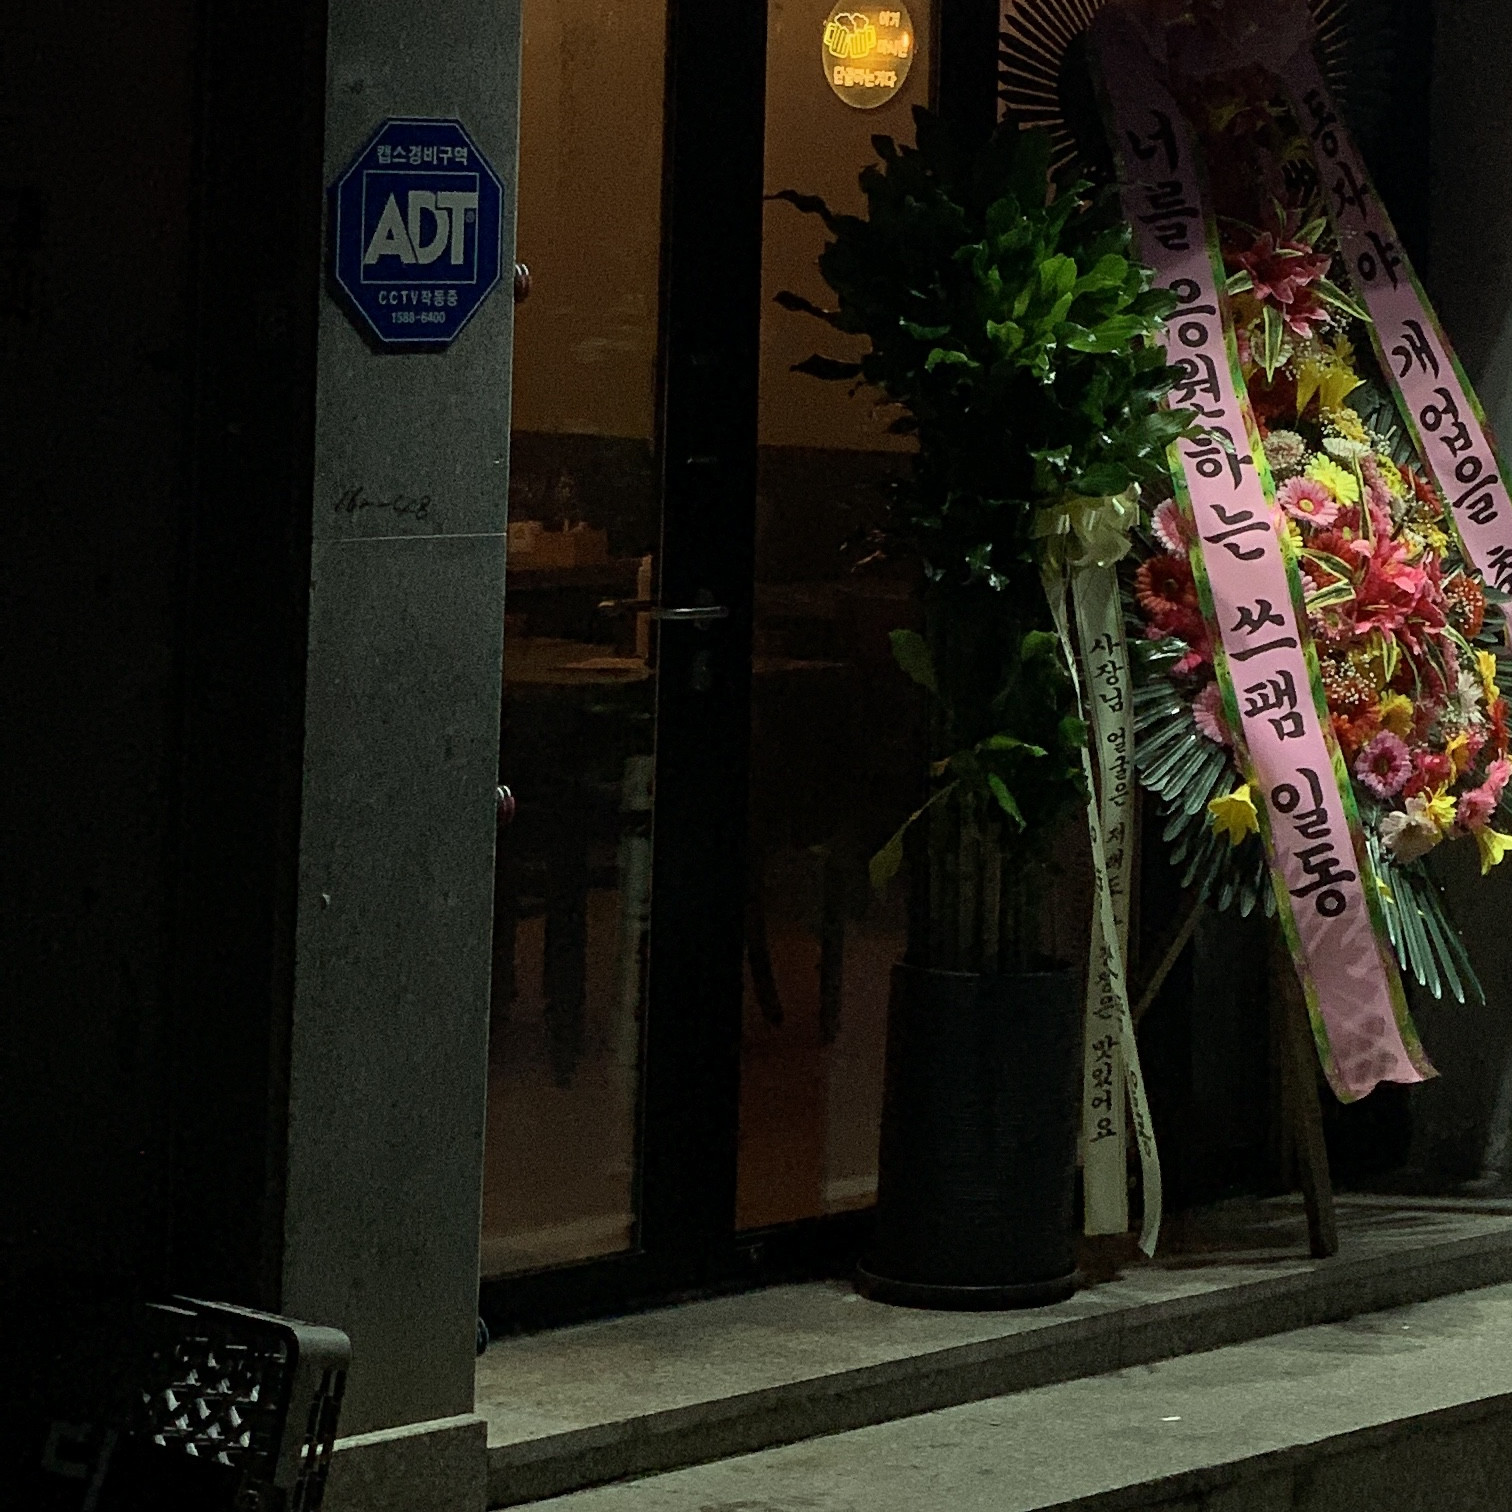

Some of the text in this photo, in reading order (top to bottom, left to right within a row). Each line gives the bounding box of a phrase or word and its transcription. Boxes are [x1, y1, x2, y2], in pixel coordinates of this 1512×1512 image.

[376, 144, 469, 166] 캡스경비구역
[362, 190, 479, 265] ADT
[1391, 319, 1499, 526] 개업을
[1124, 108, 1200, 251] 너를
[1228, 598, 1306, 742] 쓰팸
[1271, 767, 1357, 920] 일동
[1089, 632, 1125, 714] 사장님
